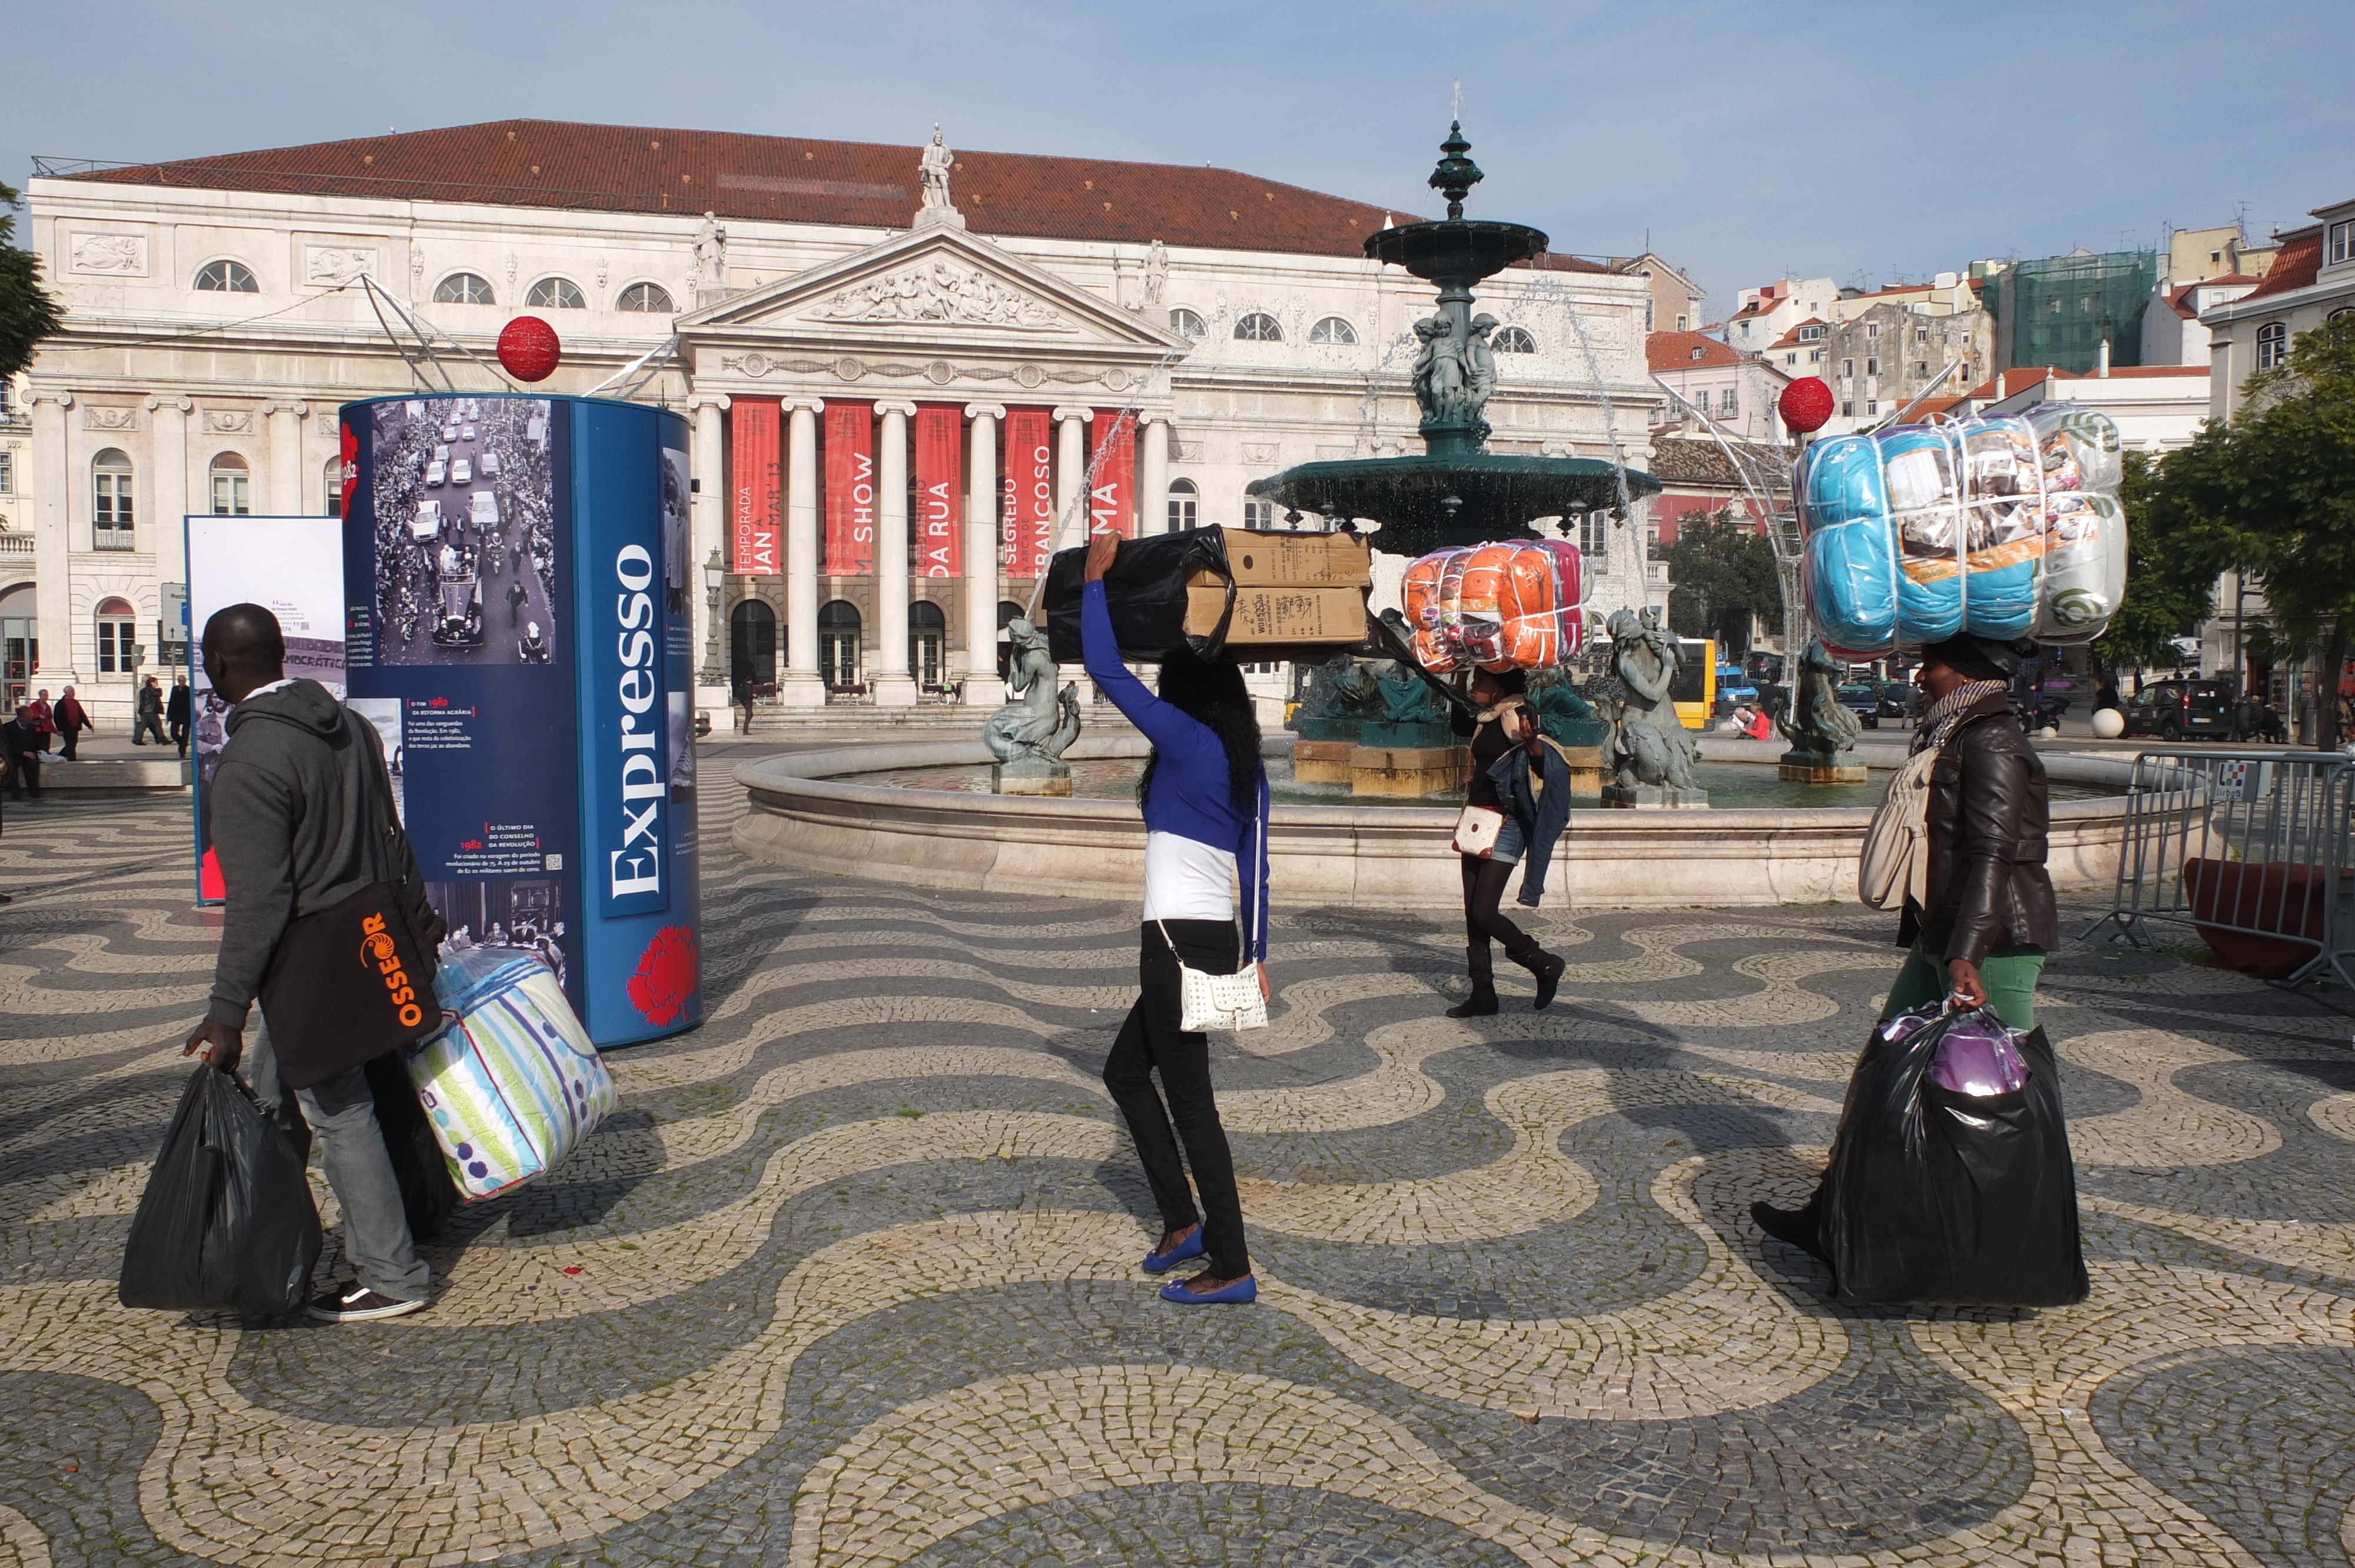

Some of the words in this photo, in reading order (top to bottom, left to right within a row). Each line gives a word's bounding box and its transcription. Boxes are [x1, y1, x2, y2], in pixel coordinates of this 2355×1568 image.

[739, 487, 751, 573] TEMPORADA
[928, 481, 949, 536] RUA
[1005, 479, 1017, 565] SEGREDO
[1021, 518, 1029, 530] DE
[754, 533, 772, 574] JAN
[612, 544, 665, 899] Expresso
